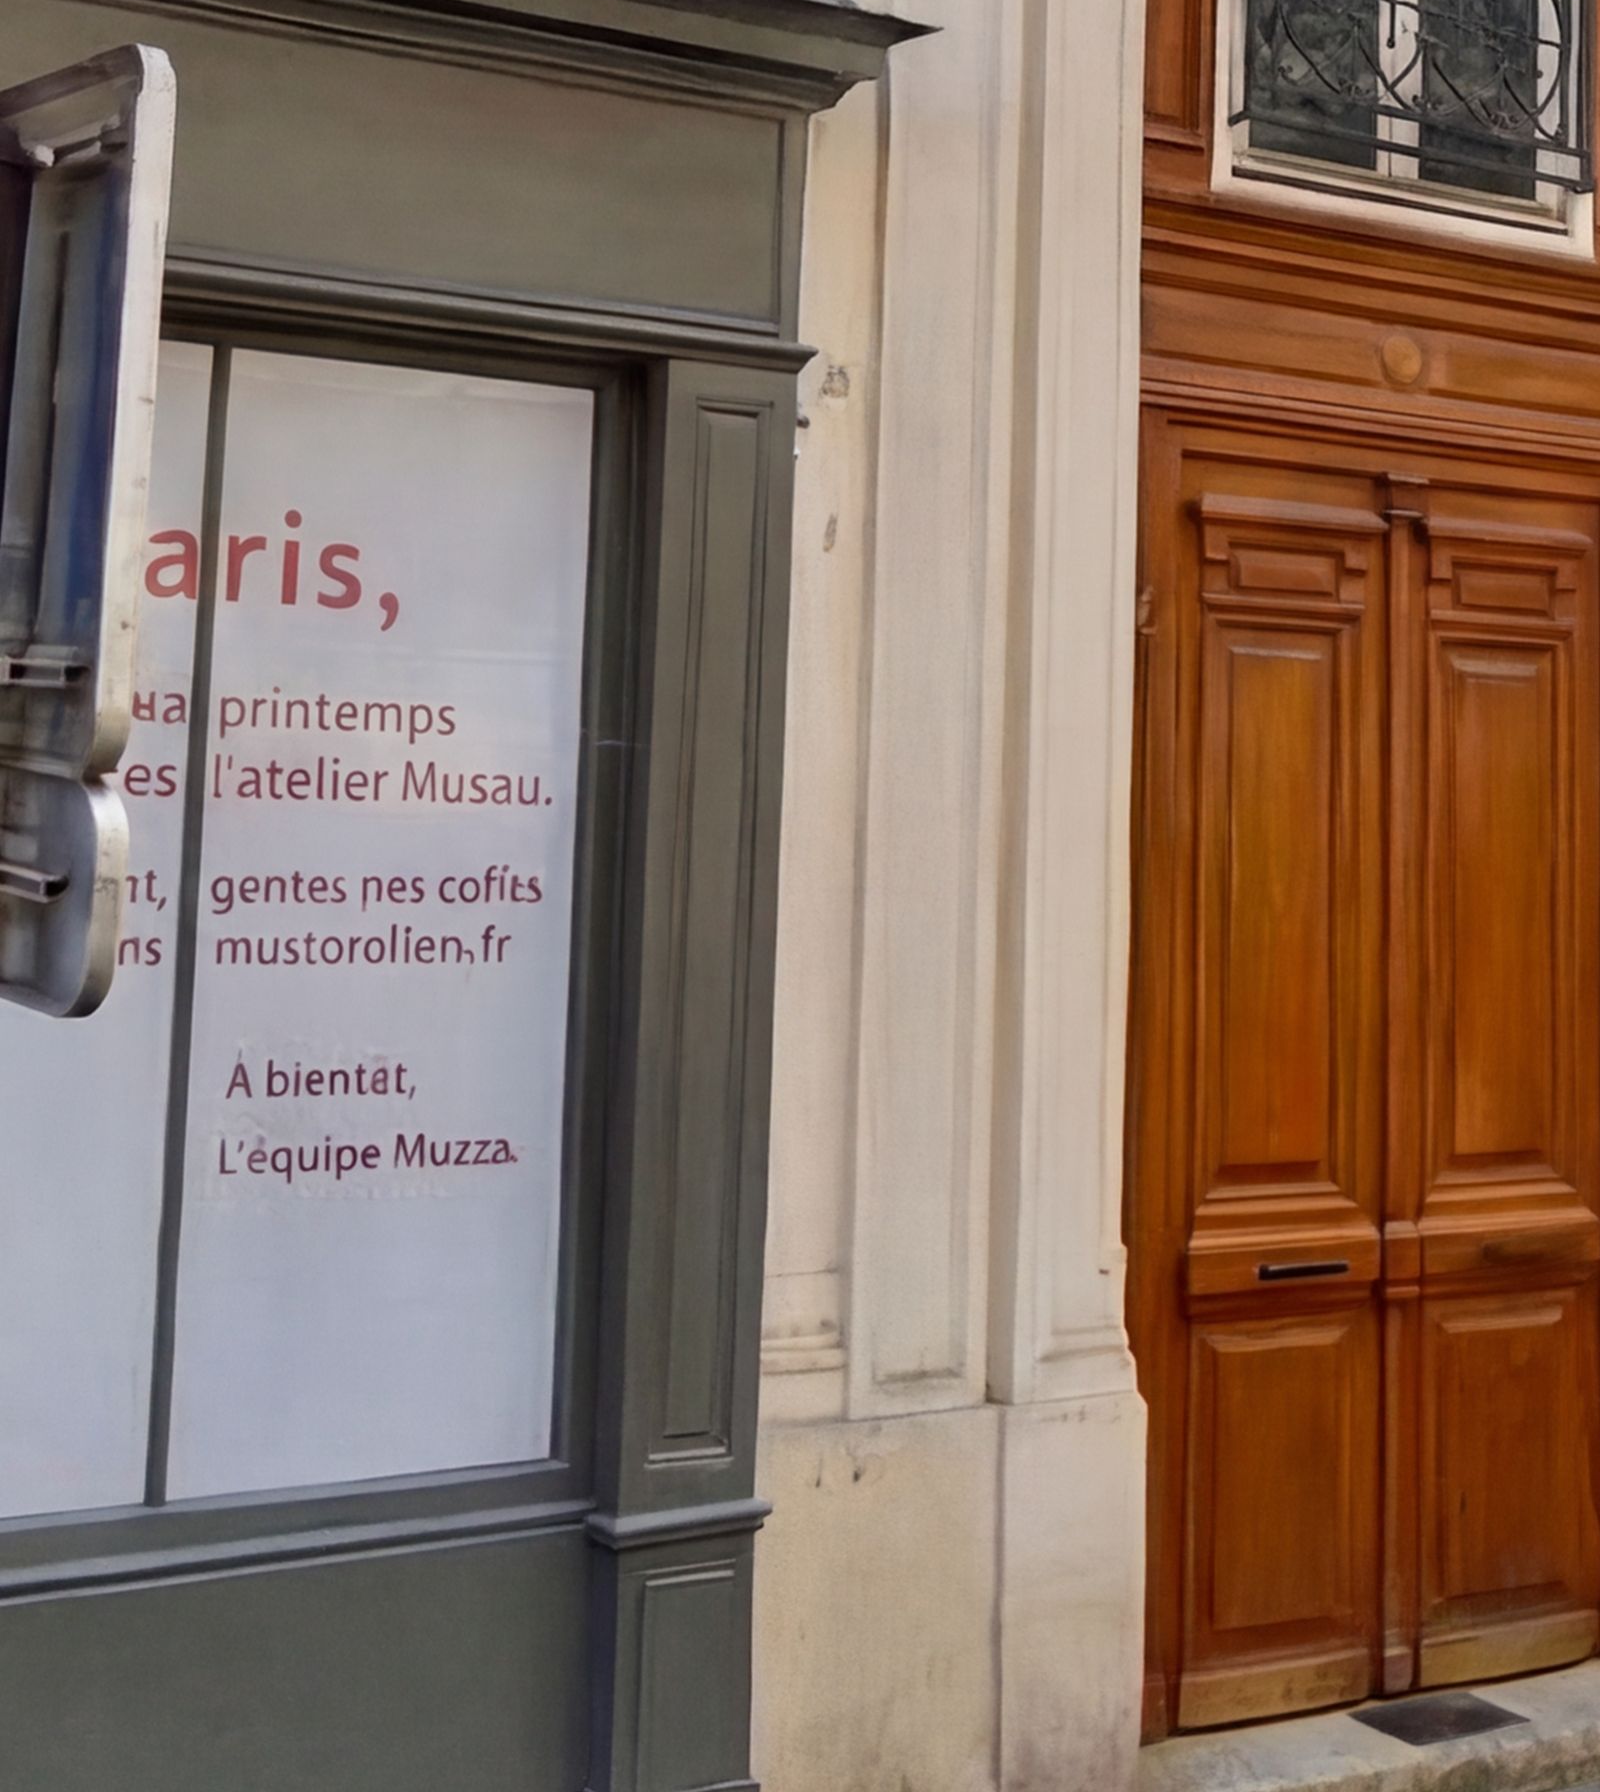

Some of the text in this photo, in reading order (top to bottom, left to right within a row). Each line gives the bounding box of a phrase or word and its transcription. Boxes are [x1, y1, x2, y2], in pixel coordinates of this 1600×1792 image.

[219, 685, 458, 745] printemps
[122, 753, 554, 807] es l'atelier Musau.
[210, 870, 348, 915] gentes
